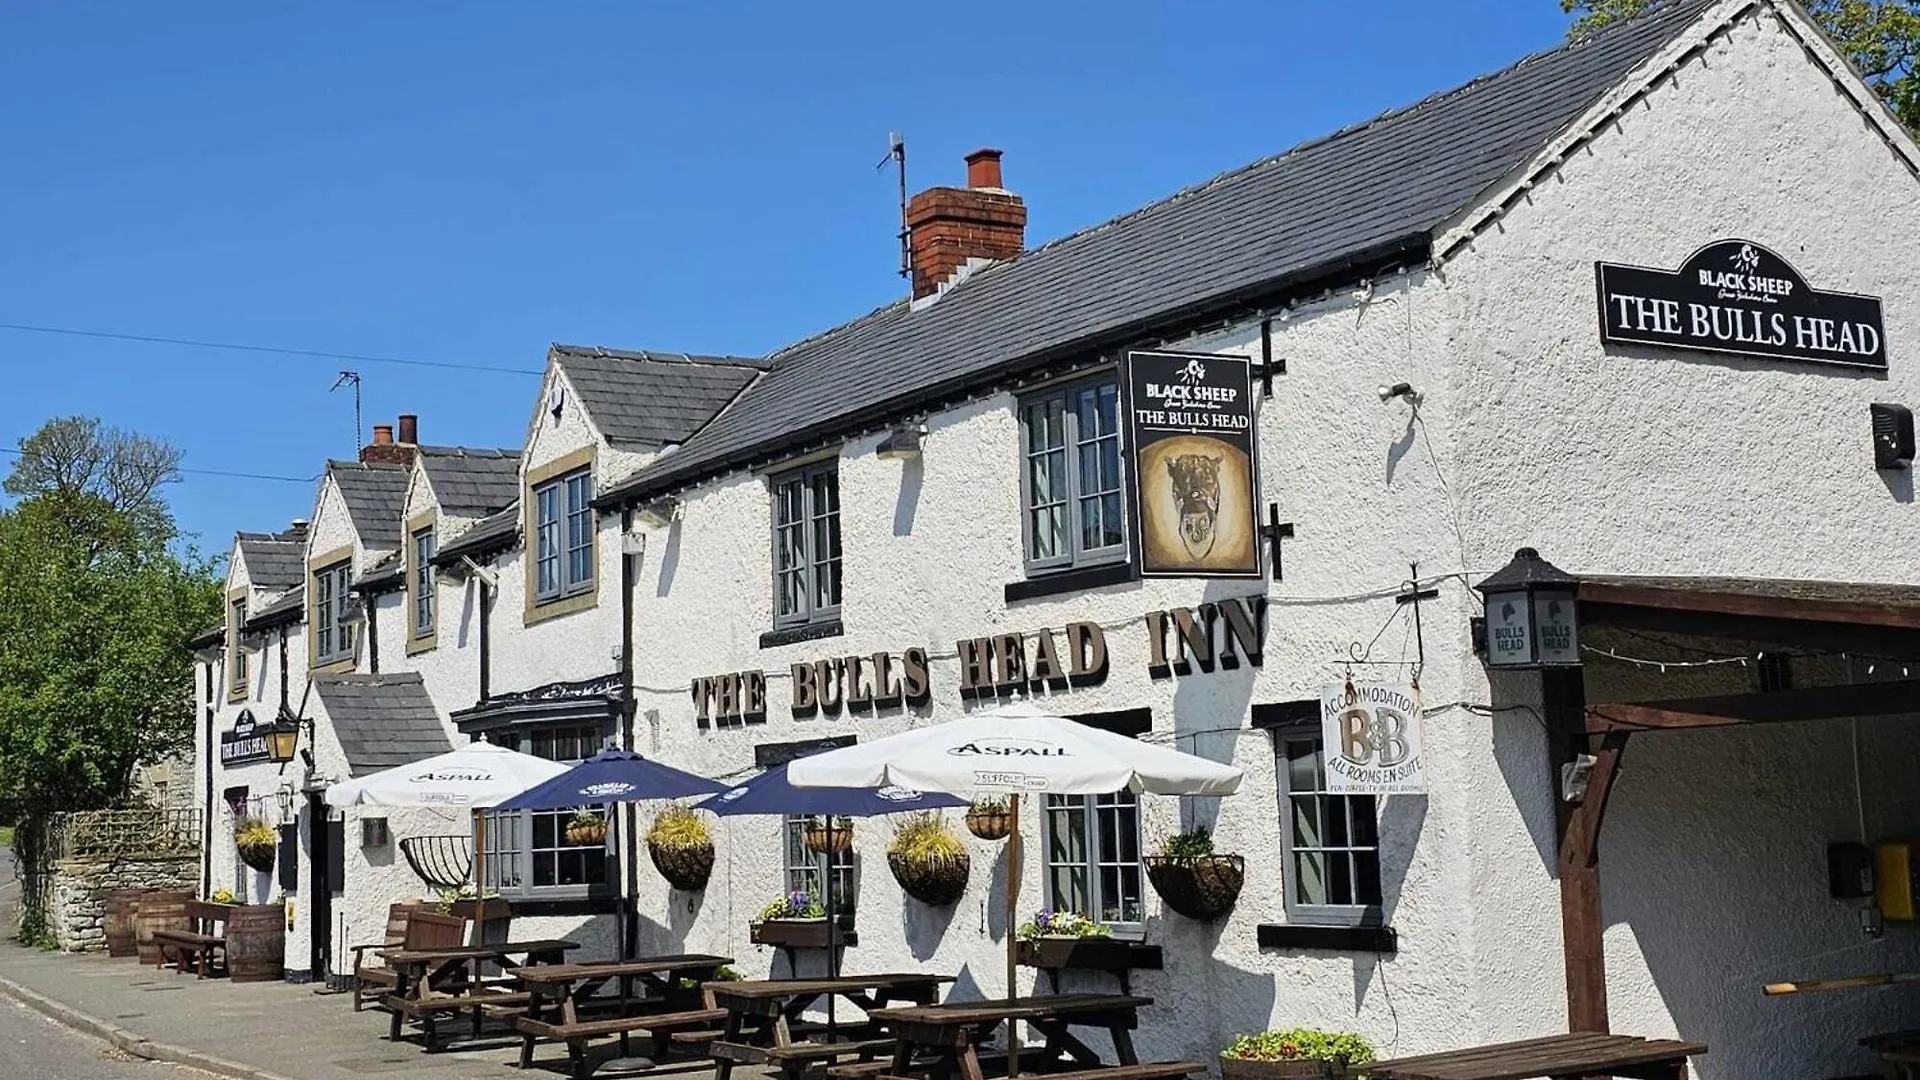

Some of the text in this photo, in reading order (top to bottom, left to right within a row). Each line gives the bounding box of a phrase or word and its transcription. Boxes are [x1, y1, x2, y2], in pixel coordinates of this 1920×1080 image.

[1699, 269, 1746, 290] BLACK
[1749, 277, 1793, 296] SHEEP
[1610, 293, 1879, 355] THE BULLS HEAD
[1146, 383, 1237, 402] BLACK SHEEP
[1136, 409, 1249, 429] THE BULLS HEAD
[1495, 626, 1525, 640] BULLS
[1541, 625, 1570, 638] BULLS
[1497, 639, 1525, 652] HEAD
[1544, 638, 1570, 650] HEAD
[692, 595, 1267, 729] THE BULLS HEAD INN
[222, 736, 268, 758] THE BULLS HEA
[947, 743, 1076, 757] ASPALL
[1328, 758, 1346, 775] ALL
[1346, 765, 1381, 784] ROOMS
